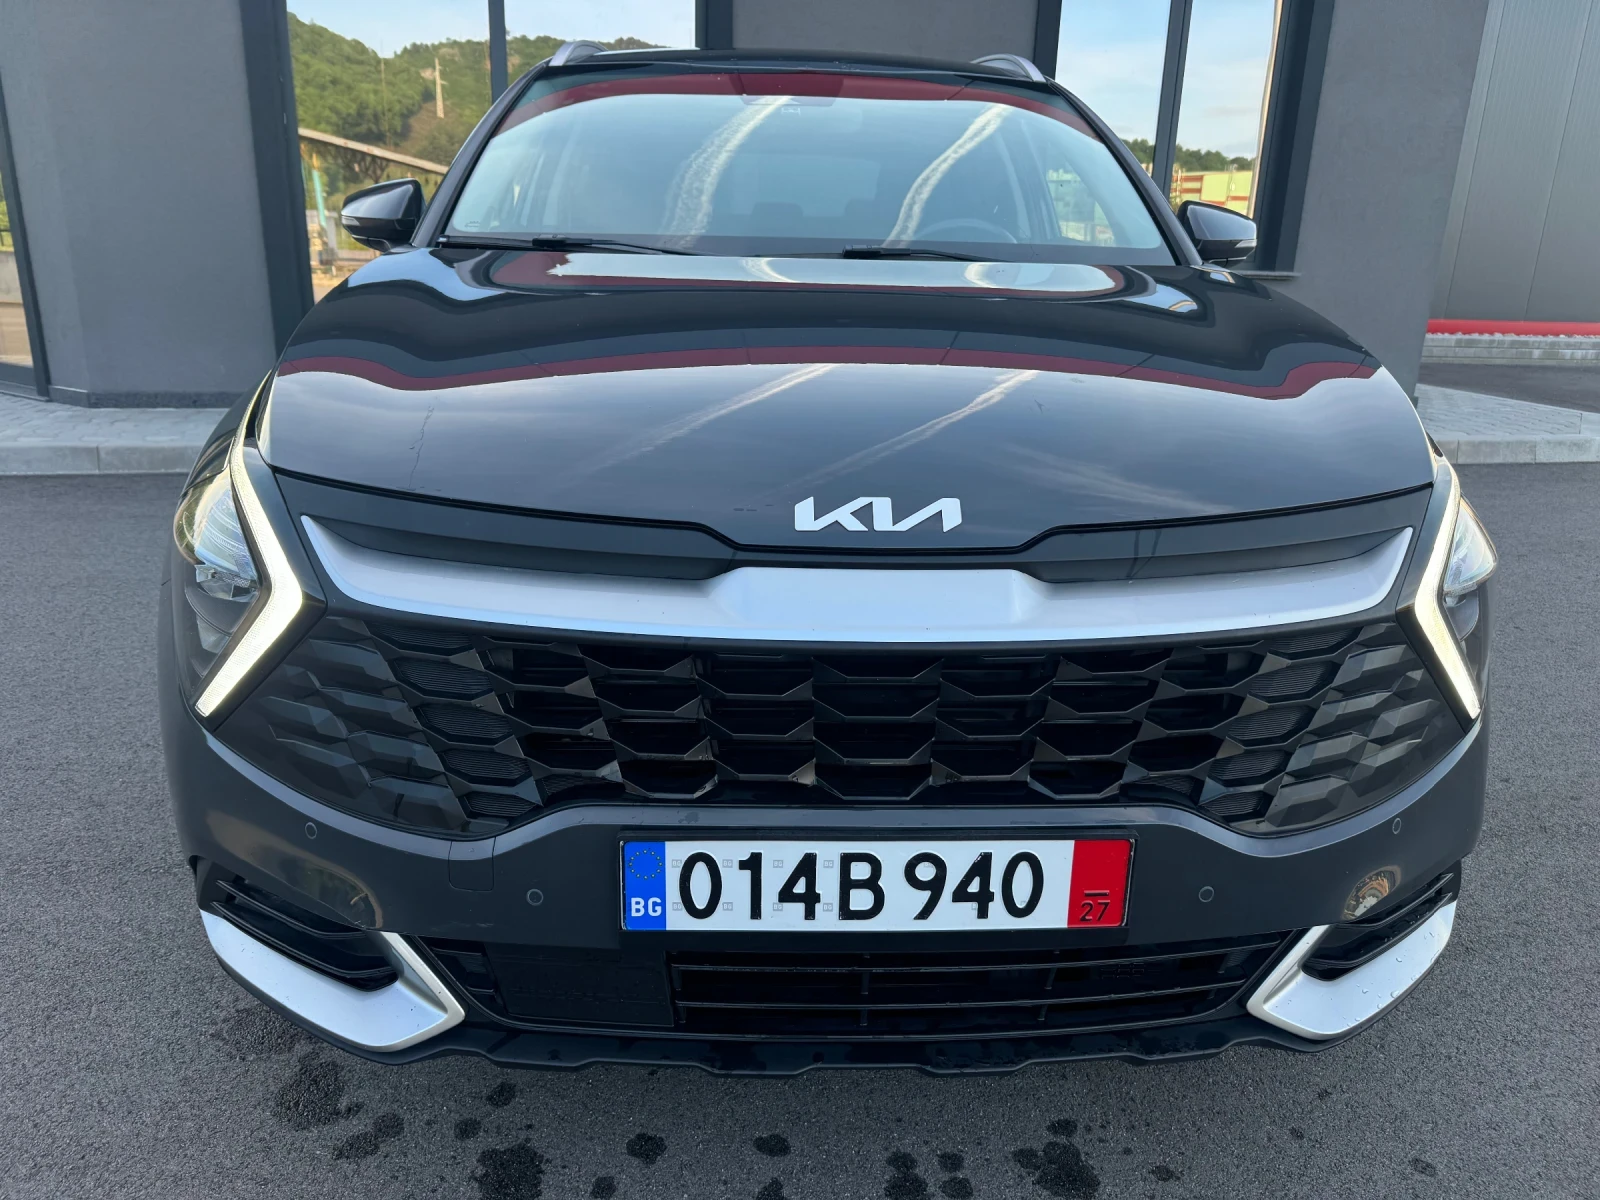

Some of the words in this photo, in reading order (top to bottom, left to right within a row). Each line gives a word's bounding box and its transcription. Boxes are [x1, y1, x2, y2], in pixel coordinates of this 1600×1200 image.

[795, 496, 962, 532] KIA
[631, 897, 662, 917] BG
[1080, 900, 1110, 921] 27
